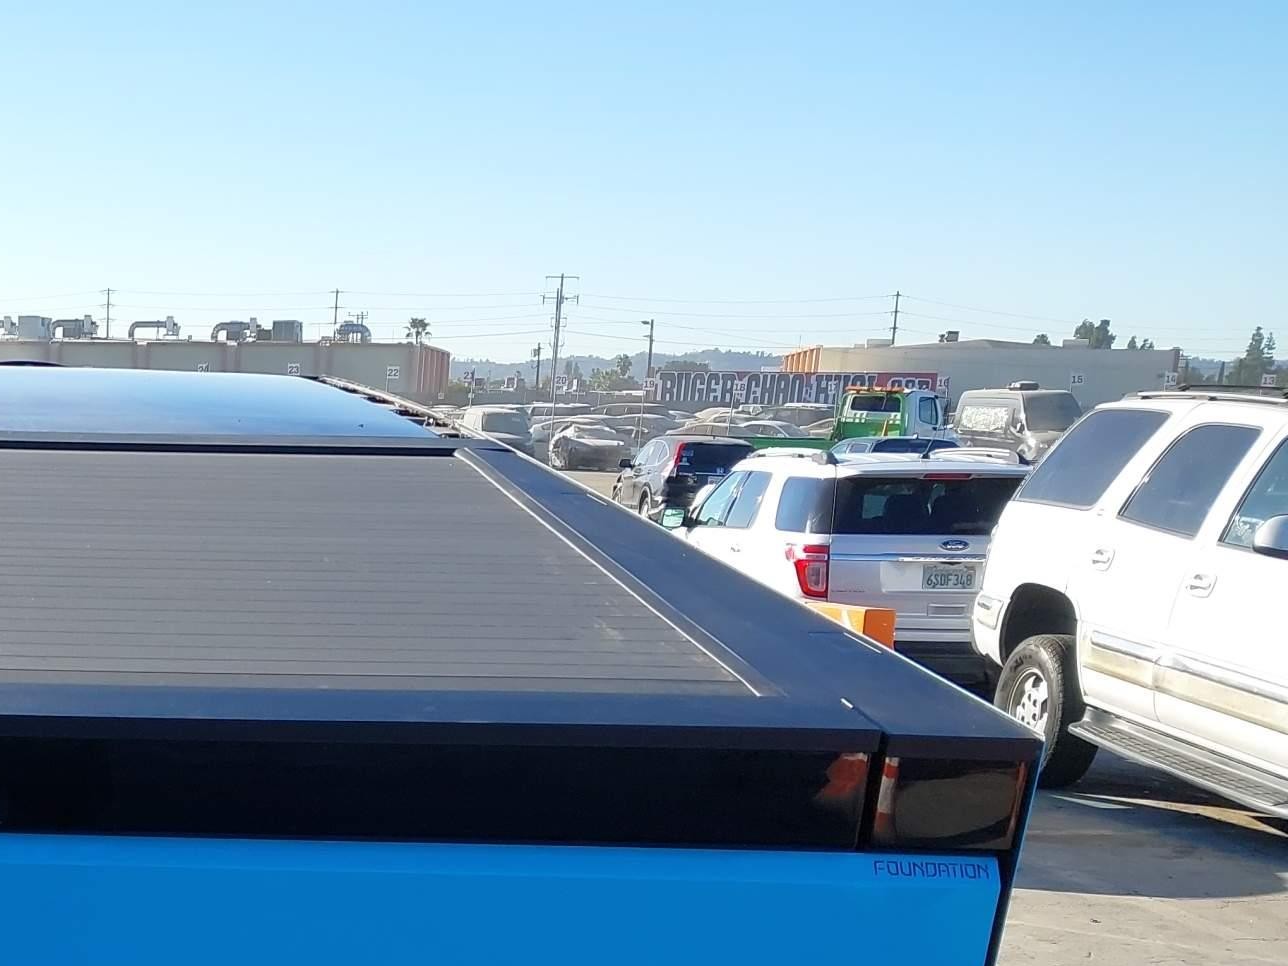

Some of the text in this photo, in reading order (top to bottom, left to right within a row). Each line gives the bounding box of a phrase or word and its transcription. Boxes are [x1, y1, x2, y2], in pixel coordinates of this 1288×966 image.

[288, 365, 300, 375] 23
[387, 368, 399, 377] 22
[555, 376, 567, 385] 20
[643, 379, 655, 389] 19
[1071, 375, 1083, 384] 15
[734, 383, 746, 392] 18
[873, 860, 990, 880] FOUNDATION
